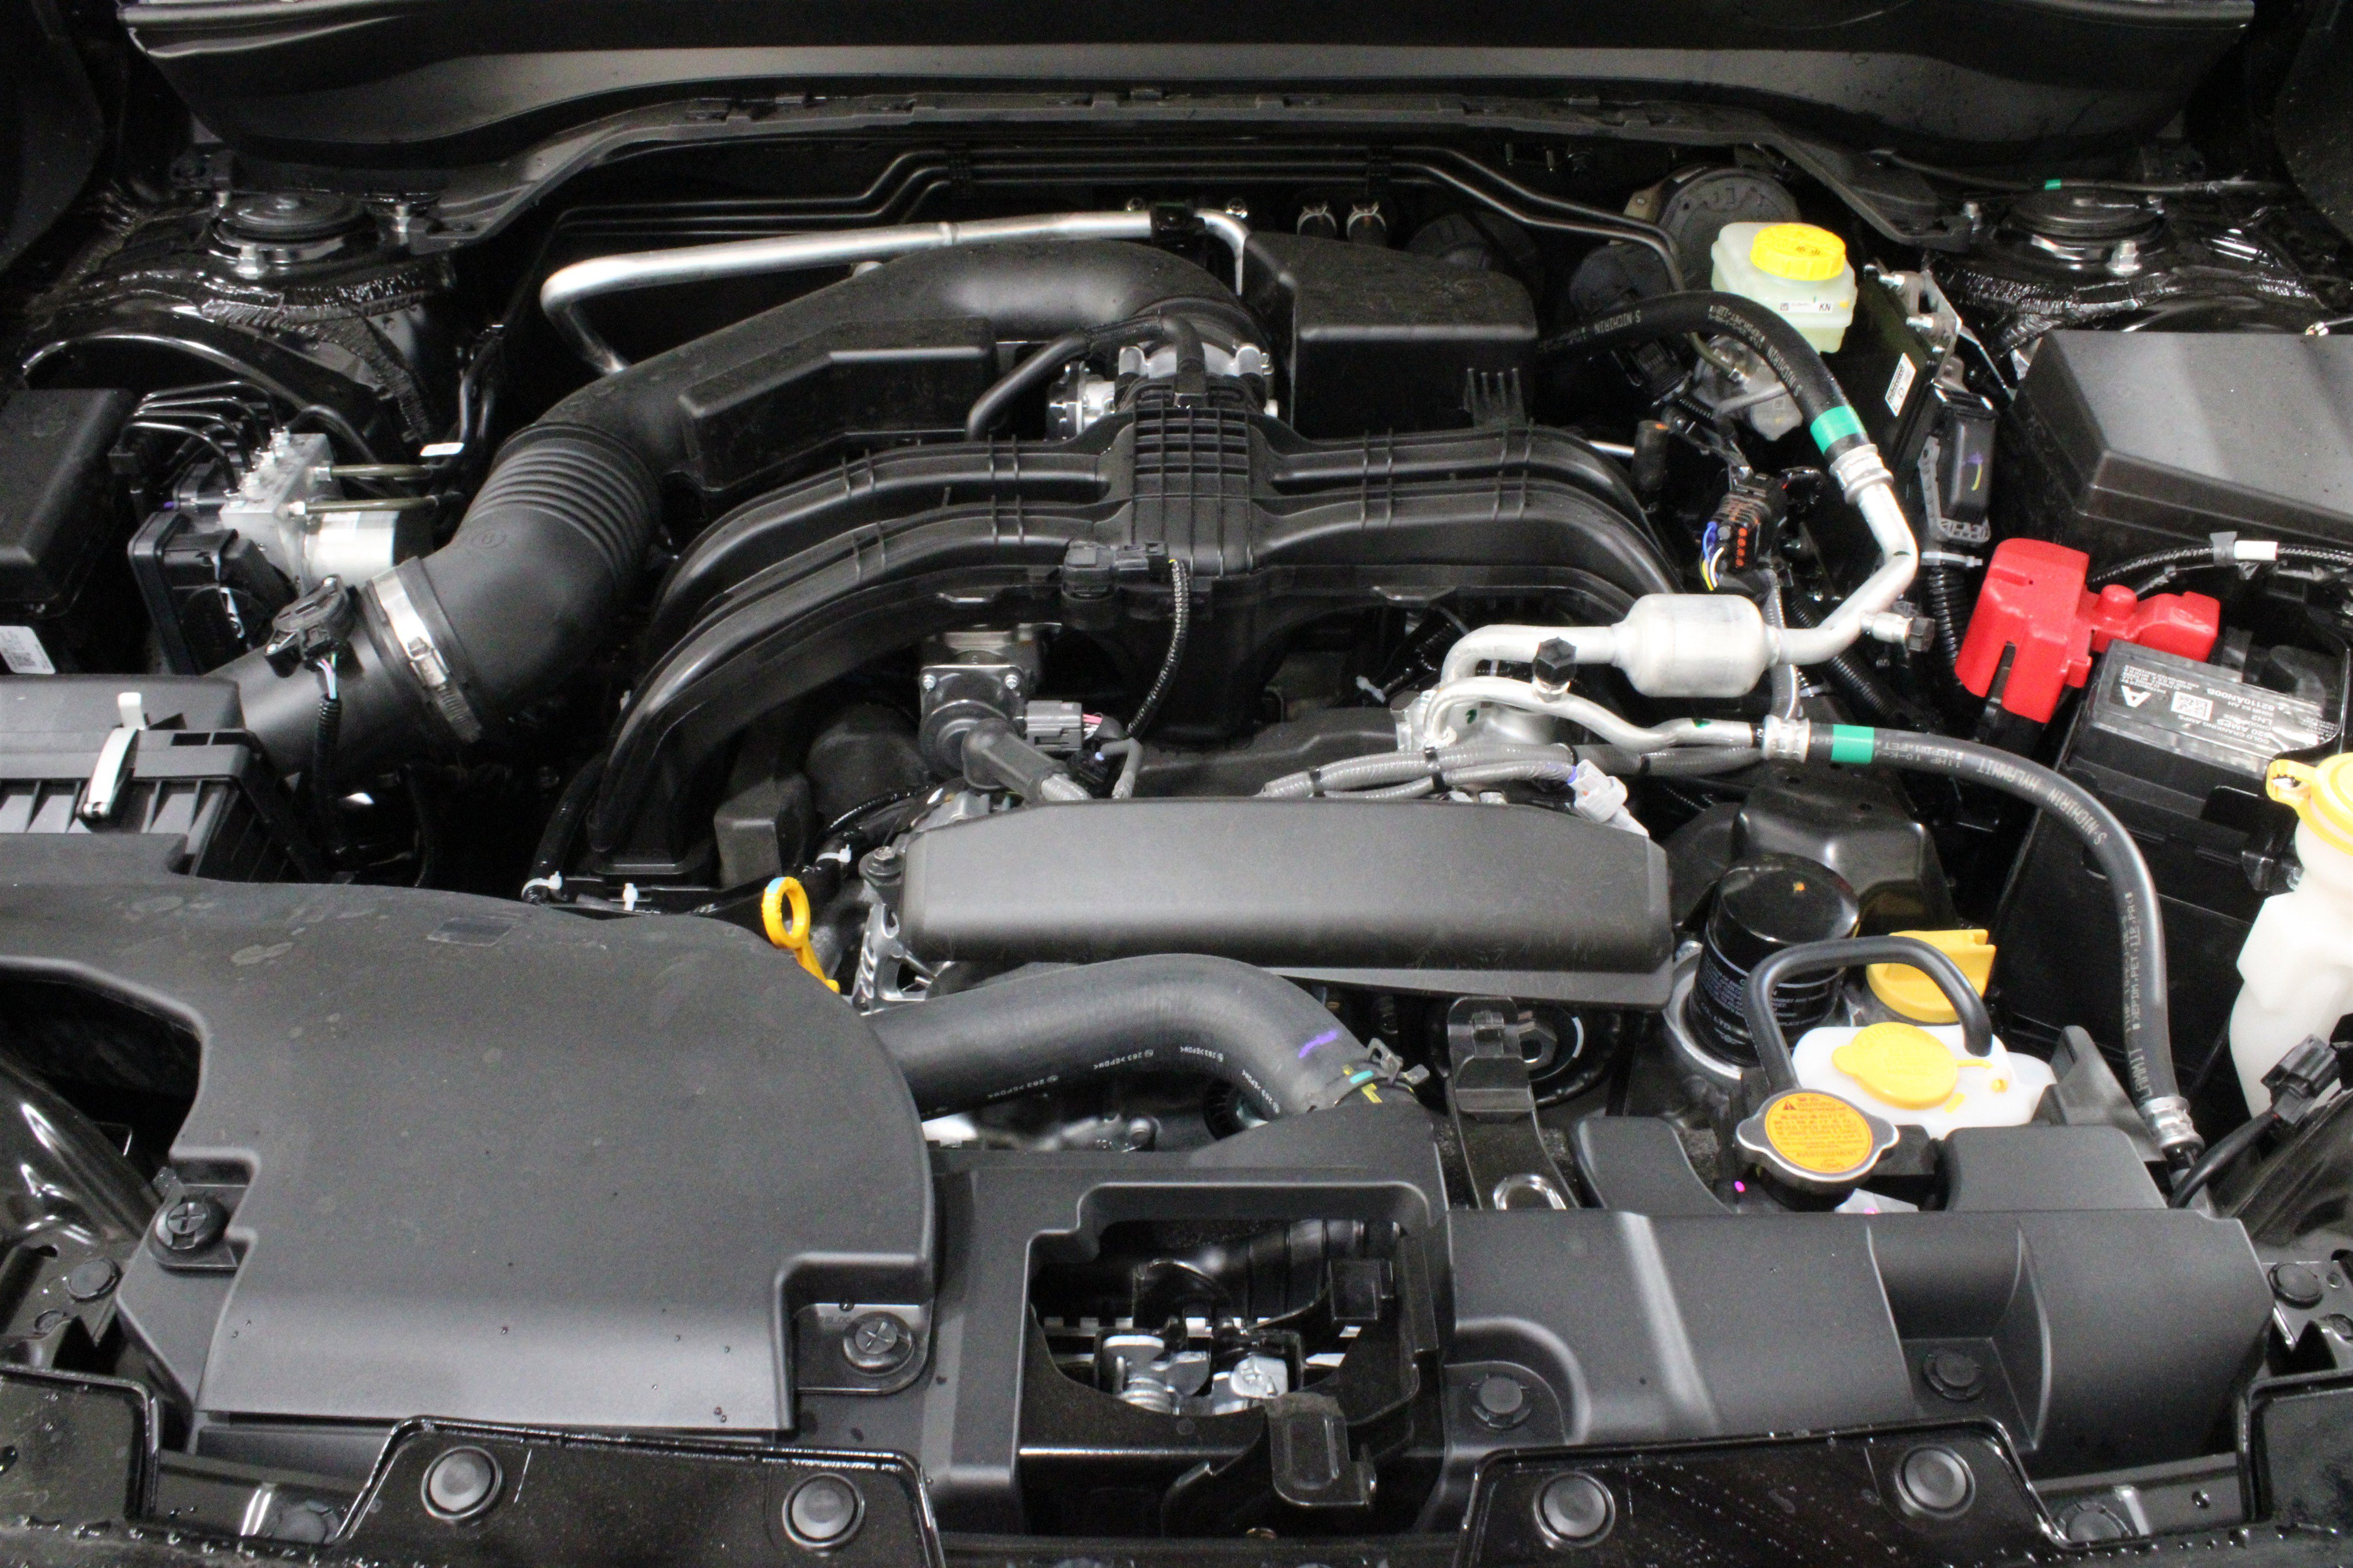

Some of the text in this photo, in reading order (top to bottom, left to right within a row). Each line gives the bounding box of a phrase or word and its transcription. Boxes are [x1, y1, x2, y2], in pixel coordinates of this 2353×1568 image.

[1819, 303, 1831, 311] KN
[2251, 715, 2273, 725] LN2
[2202, 721, 2246, 738] CRANKING
[2216, 719, 2249, 733] AMPS
[2247, 734, 2270, 744] COLD
[1796, 1150, 1857, 1158] AVERTISSEMENT
